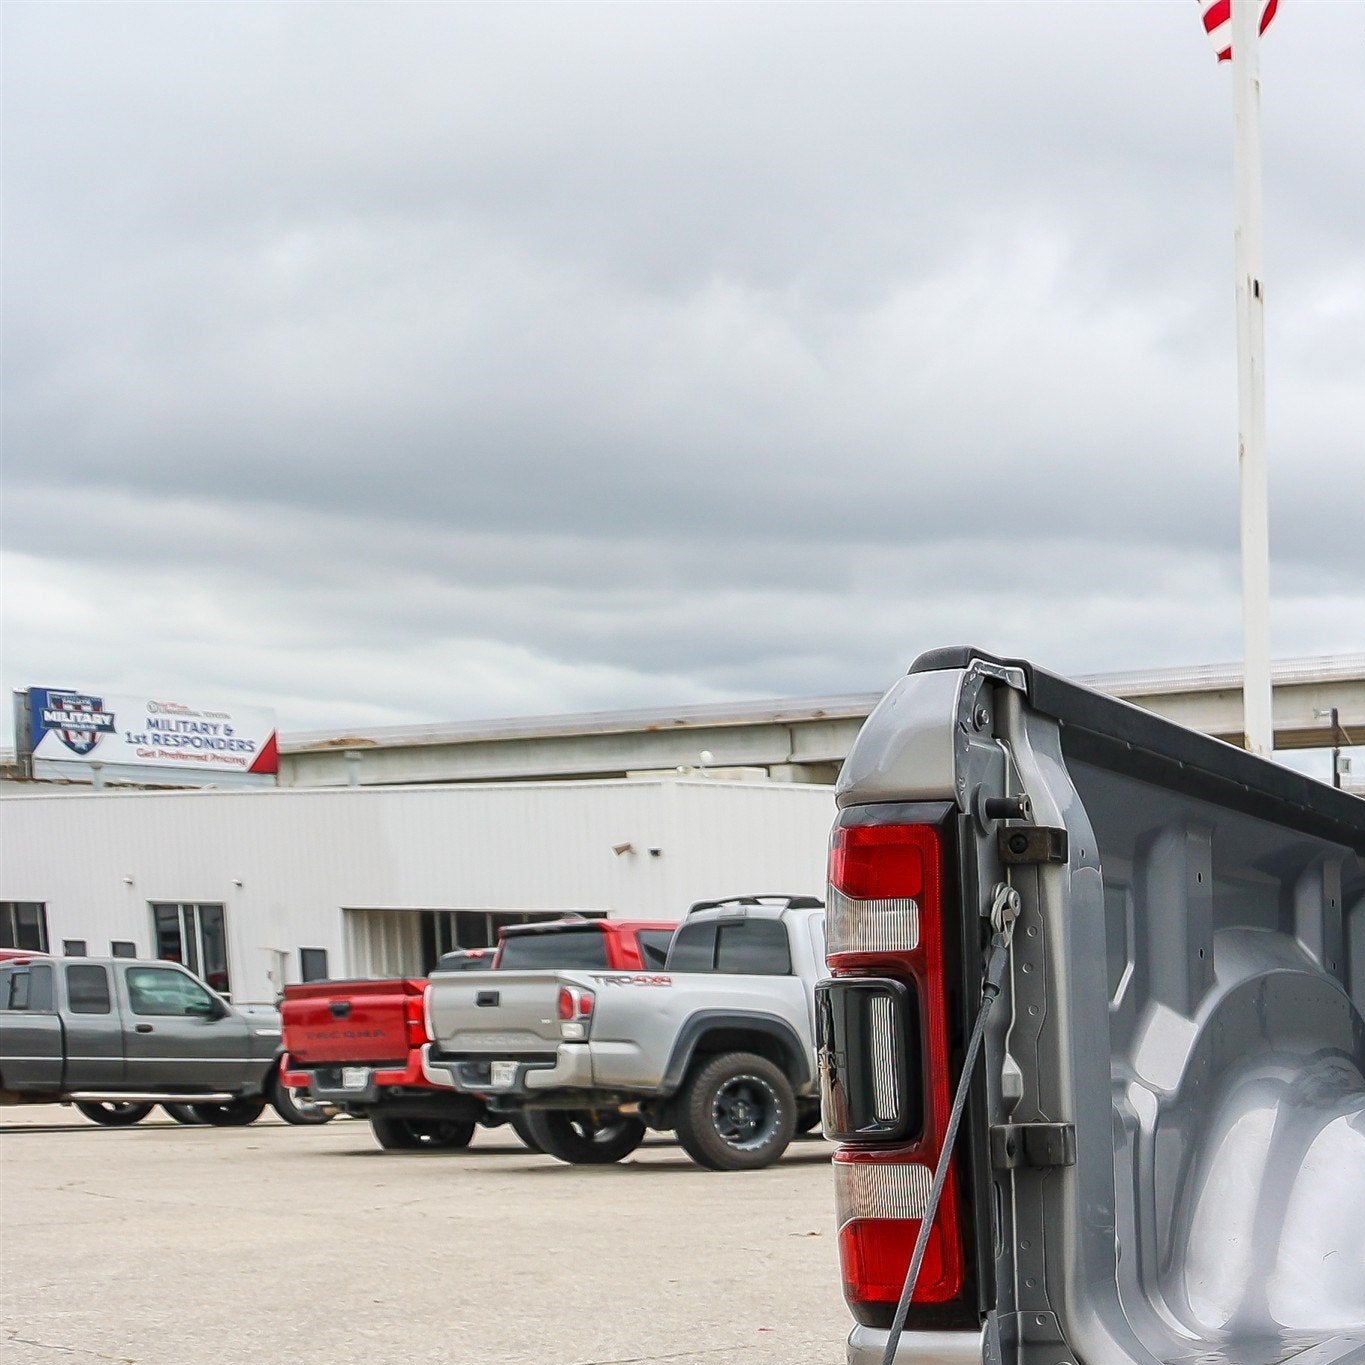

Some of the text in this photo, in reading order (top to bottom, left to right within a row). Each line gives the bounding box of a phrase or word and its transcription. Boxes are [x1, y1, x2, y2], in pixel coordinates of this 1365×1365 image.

[44, 710, 112, 725] MILITARY
[146, 718, 234, 736] MILITARY &
[125, 731, 255, 752] 1st RESPONDERS
